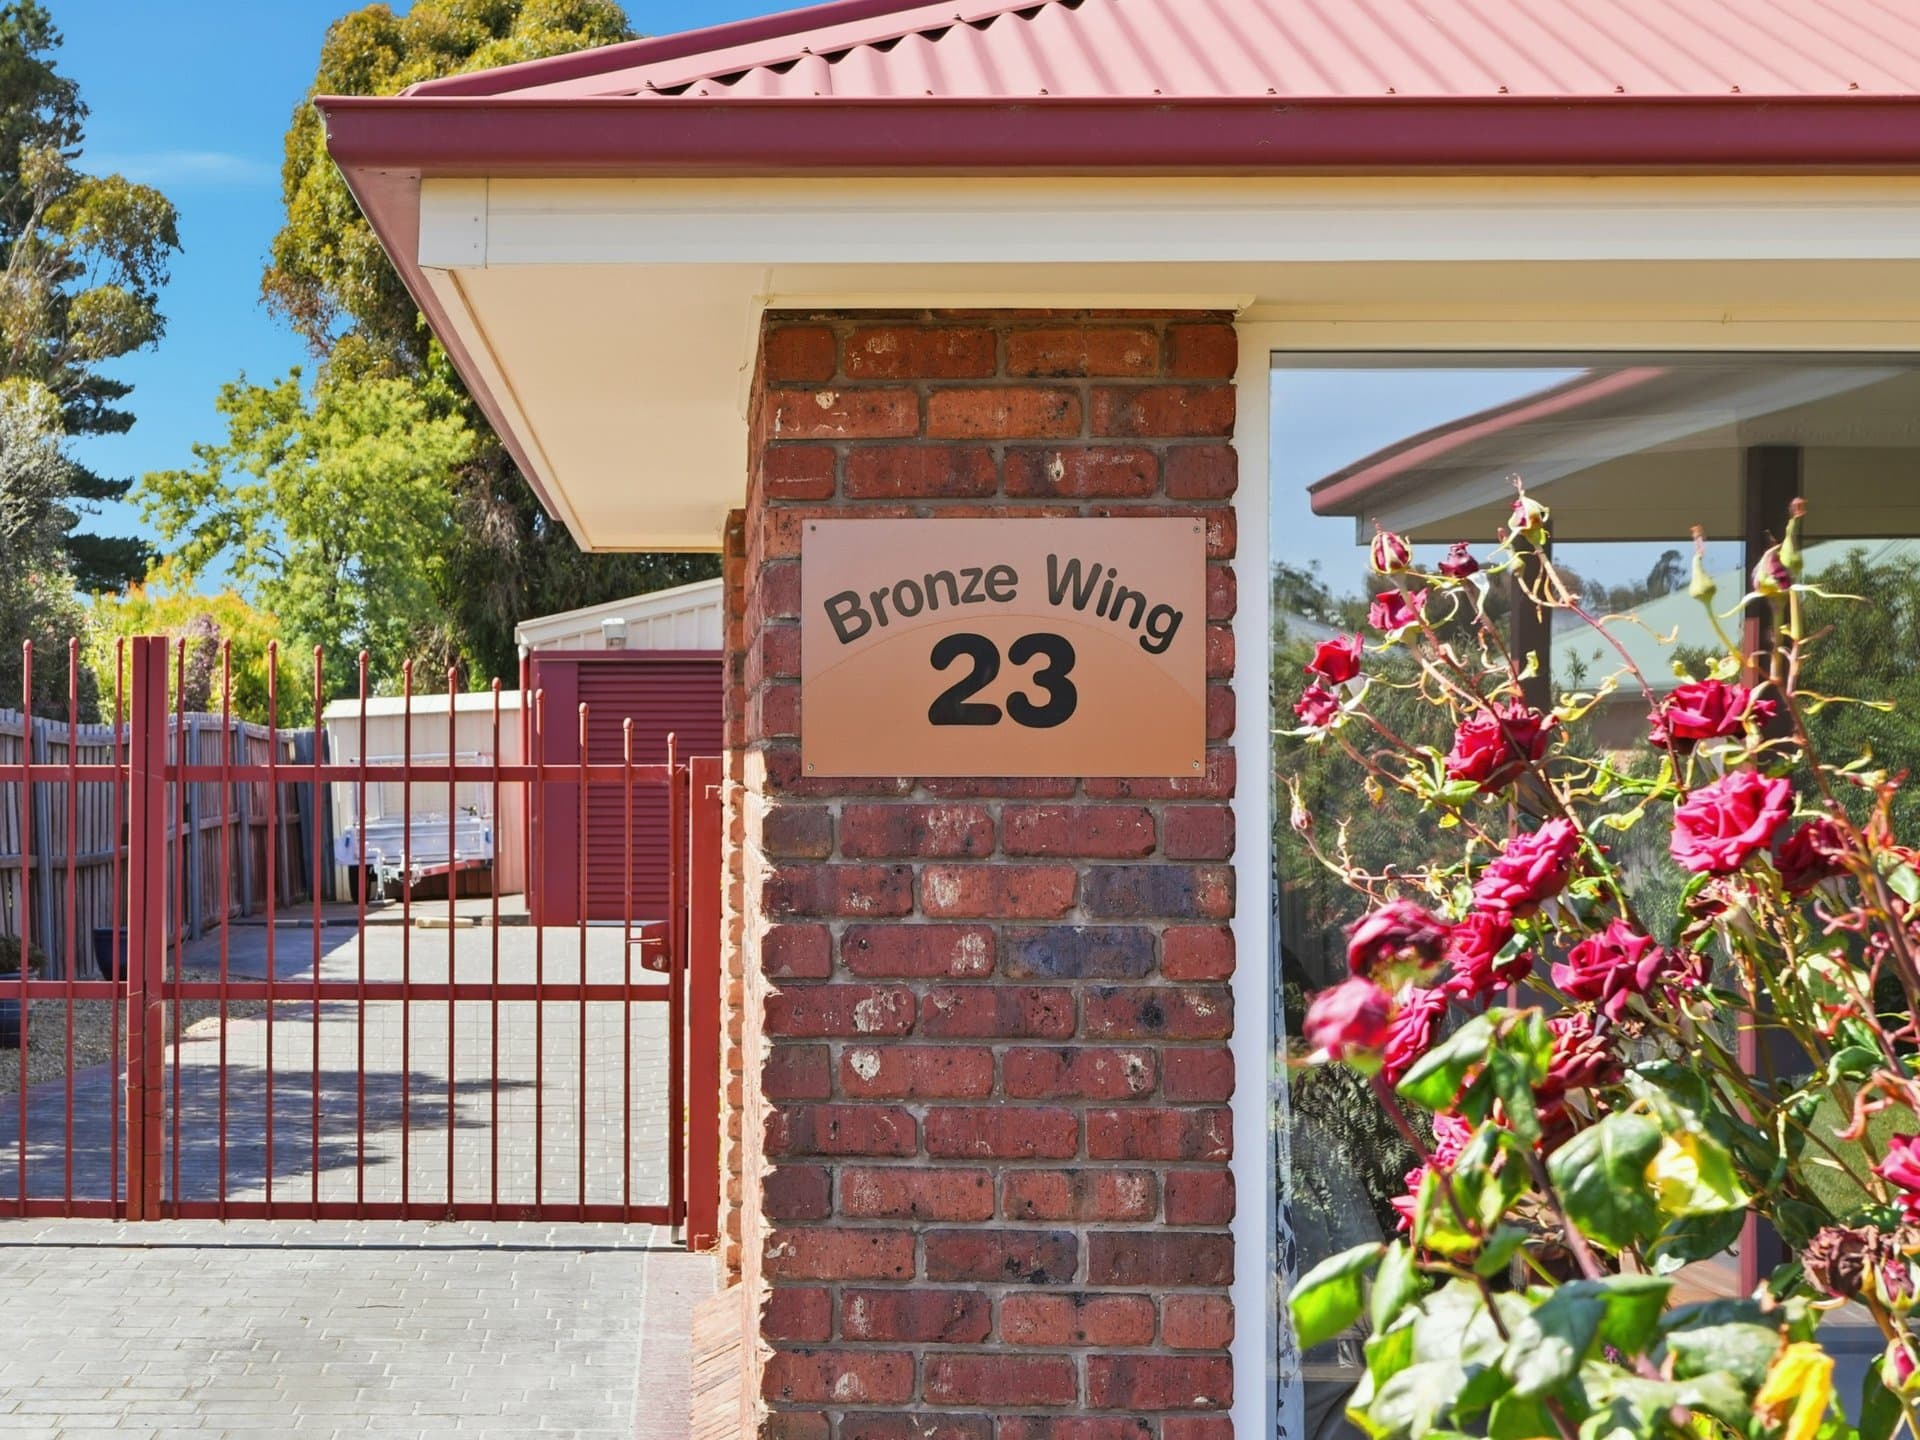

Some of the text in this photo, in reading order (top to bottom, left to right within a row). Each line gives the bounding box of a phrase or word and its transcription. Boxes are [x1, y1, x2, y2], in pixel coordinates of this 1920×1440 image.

[823, 553, 1184, 655] Bronze Wing
[927, 632, 1078, 729] 23
